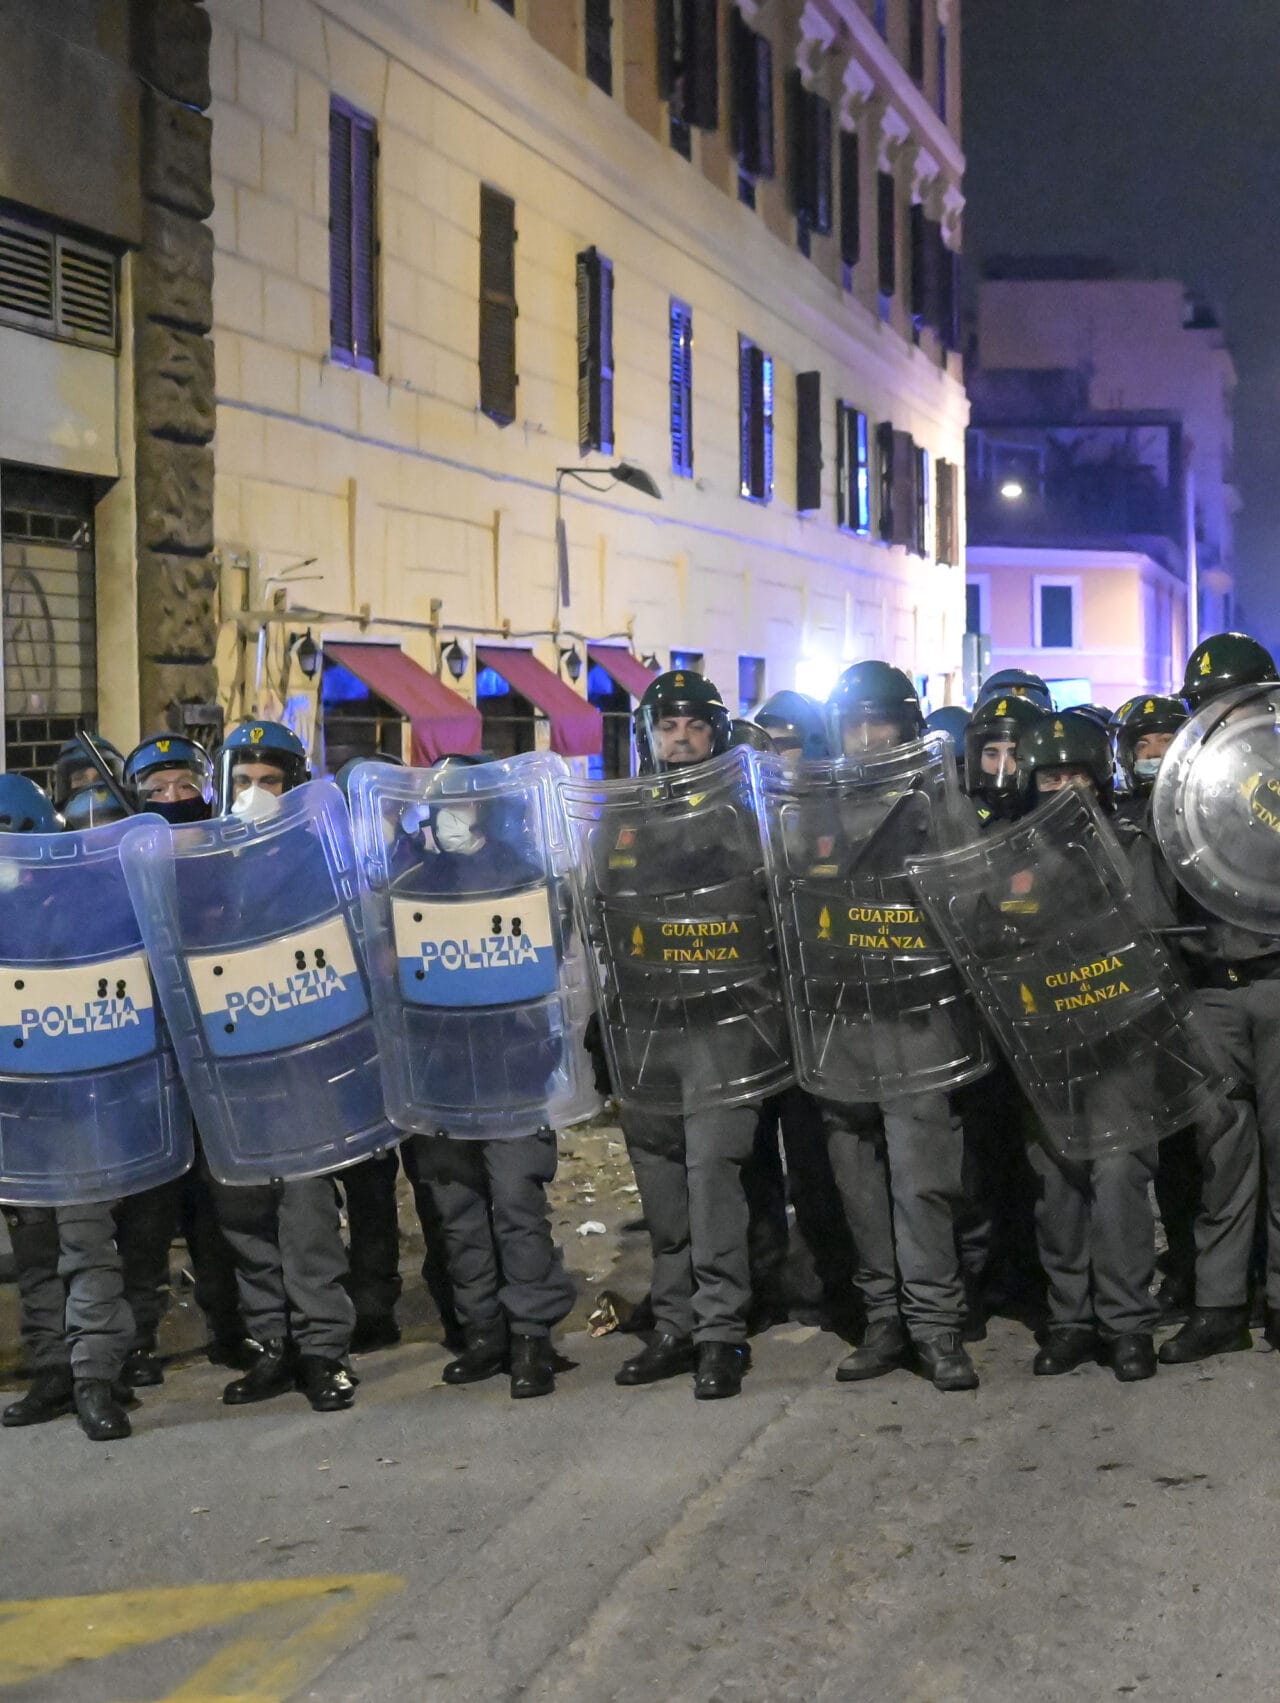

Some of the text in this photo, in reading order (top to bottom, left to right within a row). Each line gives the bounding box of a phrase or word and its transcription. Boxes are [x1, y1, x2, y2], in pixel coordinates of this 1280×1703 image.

[848, 907, 925, 923] GUARDIA
[662, 922, 739, 938] GUARDIA
[878, 924, 890, 936] di
[693, 940, 703, 948] di
[848, 933, 926, 949] FINANZA
[420, 935, 539, 970] POLIZIA
[663, 948, 740, 962] FINANZA
[1045, 956, 1123, 988] GUARDIA
[225, 965, 346, 1023] POLIZIA
[1080, 982, 1091, 992] di
[1055, 981, 1130, 1012] FINANZA
[21, 996, 140, 1037] POLIZIA
